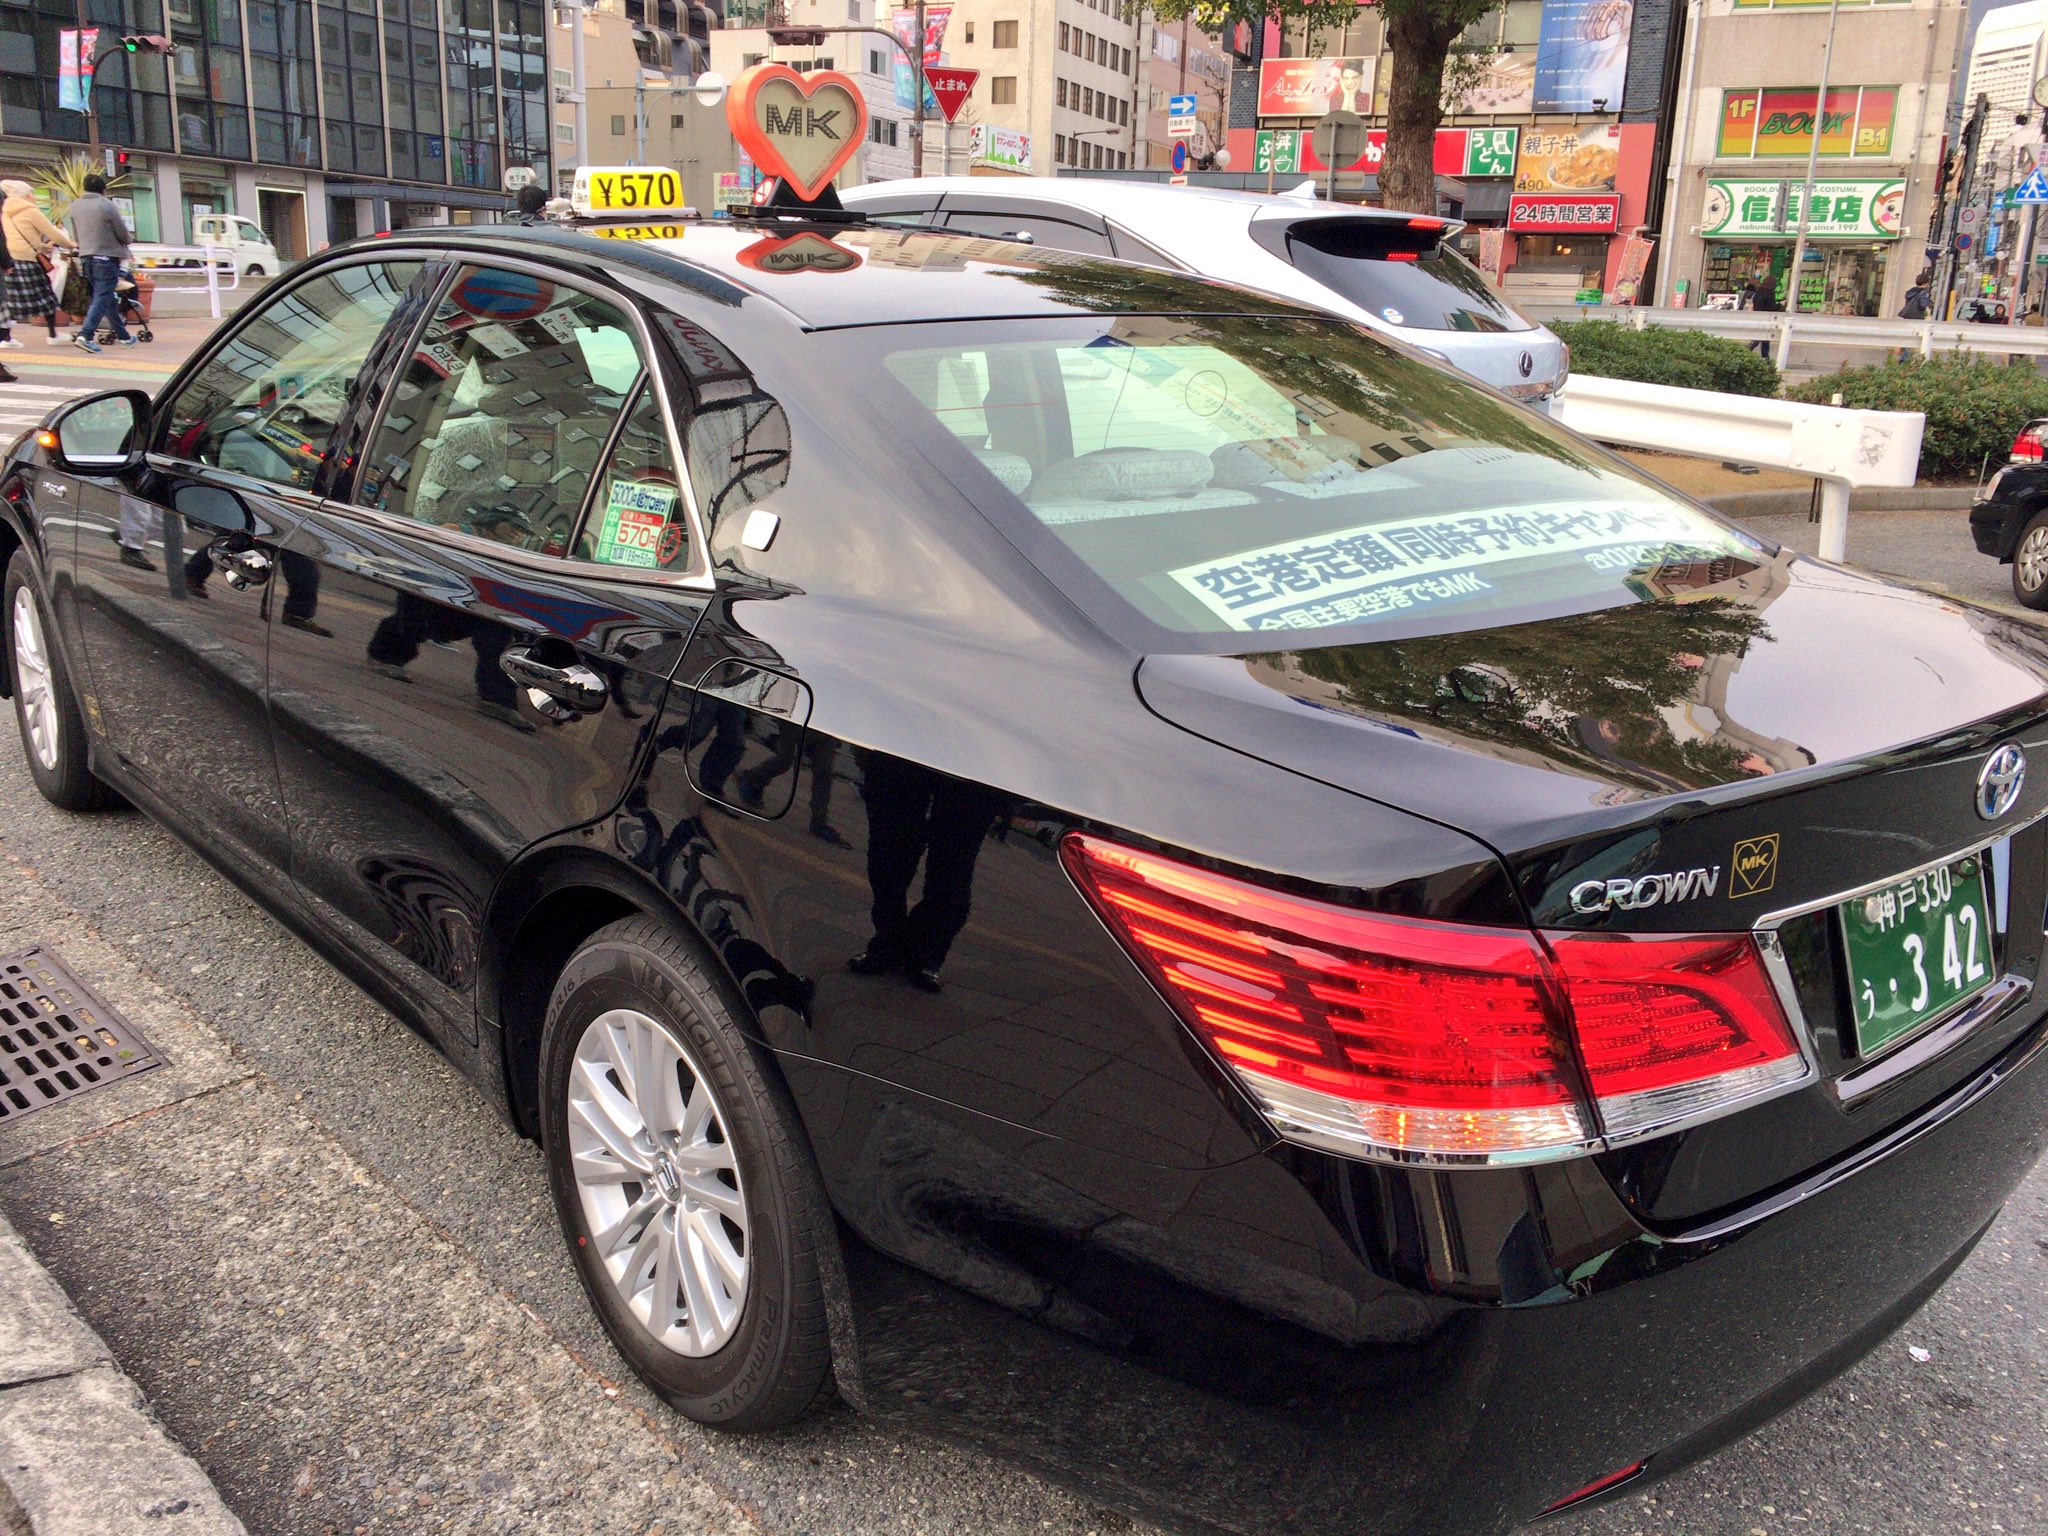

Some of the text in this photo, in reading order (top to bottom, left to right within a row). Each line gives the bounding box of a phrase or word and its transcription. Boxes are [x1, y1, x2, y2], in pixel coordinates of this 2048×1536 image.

[934, 78, 968, 92] 止まれ
[1728, 99, 1756, 118] 1F
[765, 103, 841, 140] MK
[1760, 112, 1855, 135] BOOK
[1524, 136, 1578, 154] 親子丼
[1857, 127, 1888, 147] B1
[1472, 132, 1506, 174] うどん
[597, 173, 675, 207] ¥570
[1513, 205, 1612, 223] 24時間営業
[1741, 195, 1863, 223] 信長書店
[1838, 223, 1859, 231] 1992
[617, 523, 657, 550] 570円
[1193, 532, 1408, 611] 空港定額
[1741, 851, 1768, 871] MK
[1568, 866, 1721, 914] CROWN
[1862, 979, 1875, 1020] う
